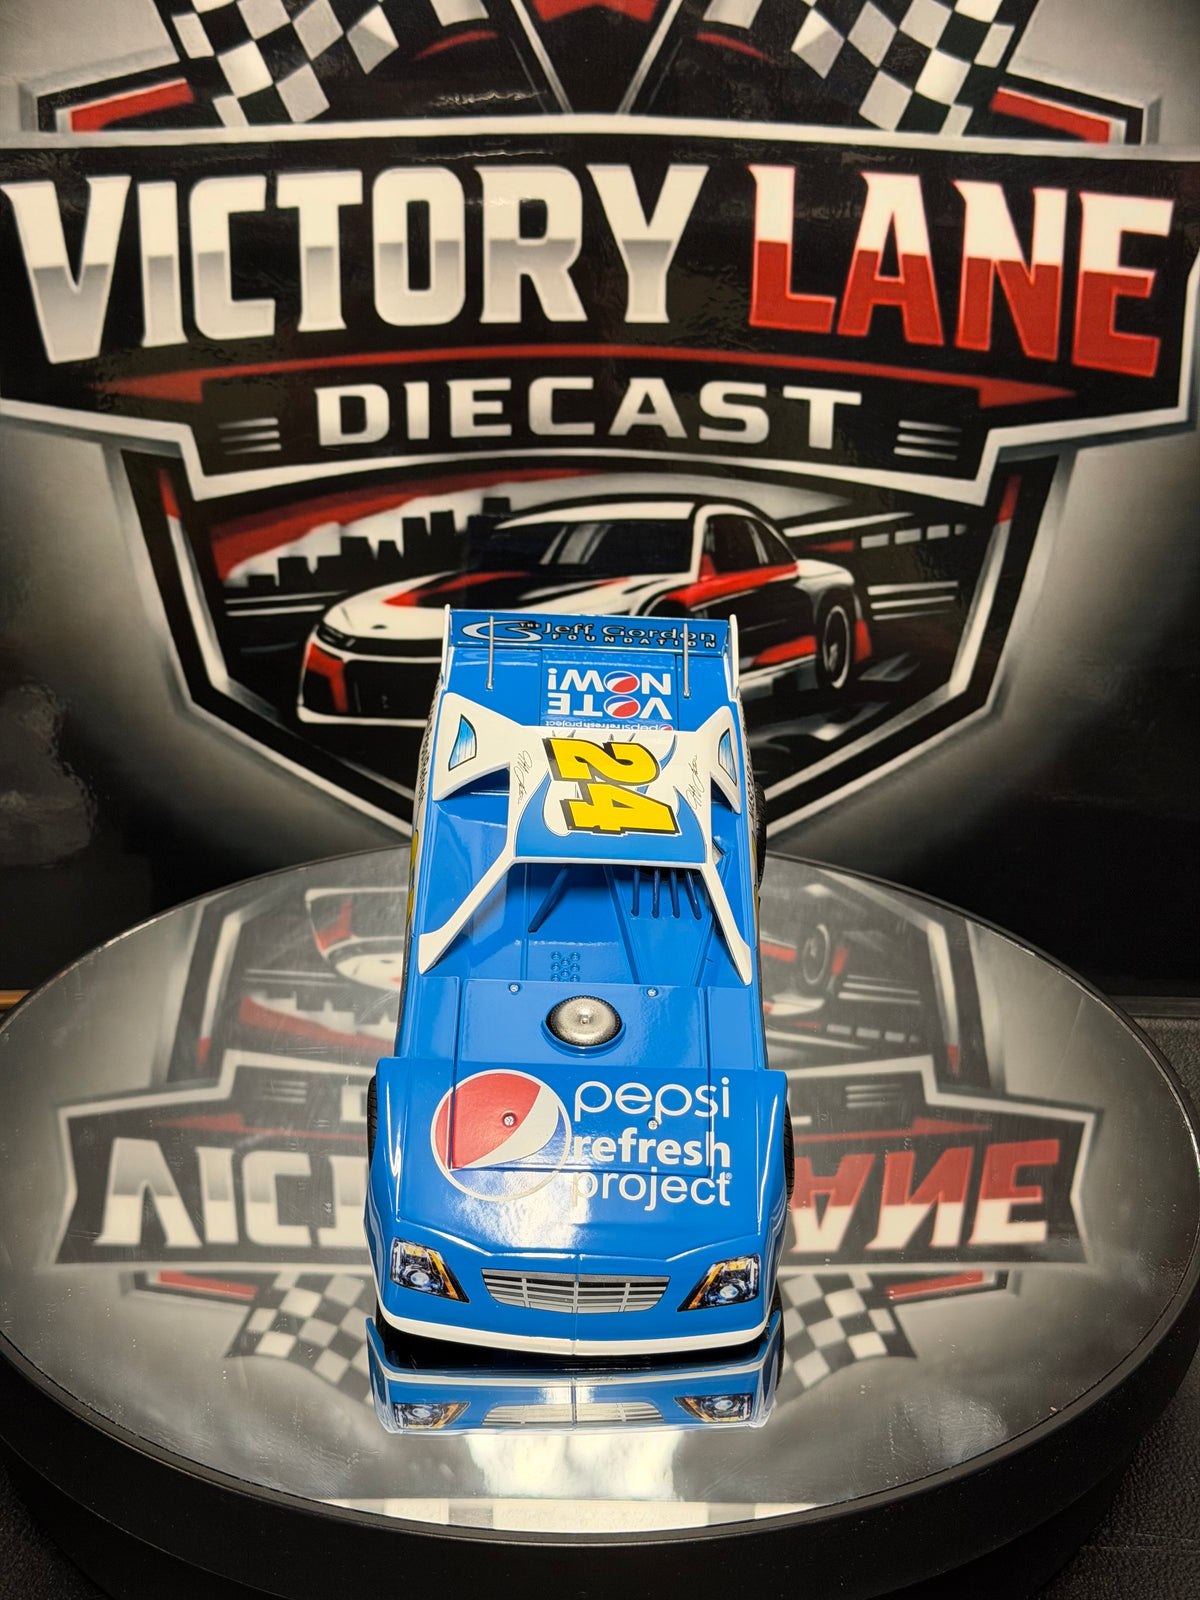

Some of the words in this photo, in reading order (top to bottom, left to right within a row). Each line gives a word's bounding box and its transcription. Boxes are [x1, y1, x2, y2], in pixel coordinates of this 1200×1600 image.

[0, 164, 709, 364] VICTORY
[748, 164, 1174, 377] LANE
[315, 376, 862, 450] DIECAST
[541, 622, 595, 636] Jeff
[601, 625, 717, 642] Gordon
[551, 633, 718, 649] FOUNDATION
[542, 737, 683, 835] 24
[574, 1076, 730, 1125] pepsi
[573, 1126, 731, 1168] refresh
